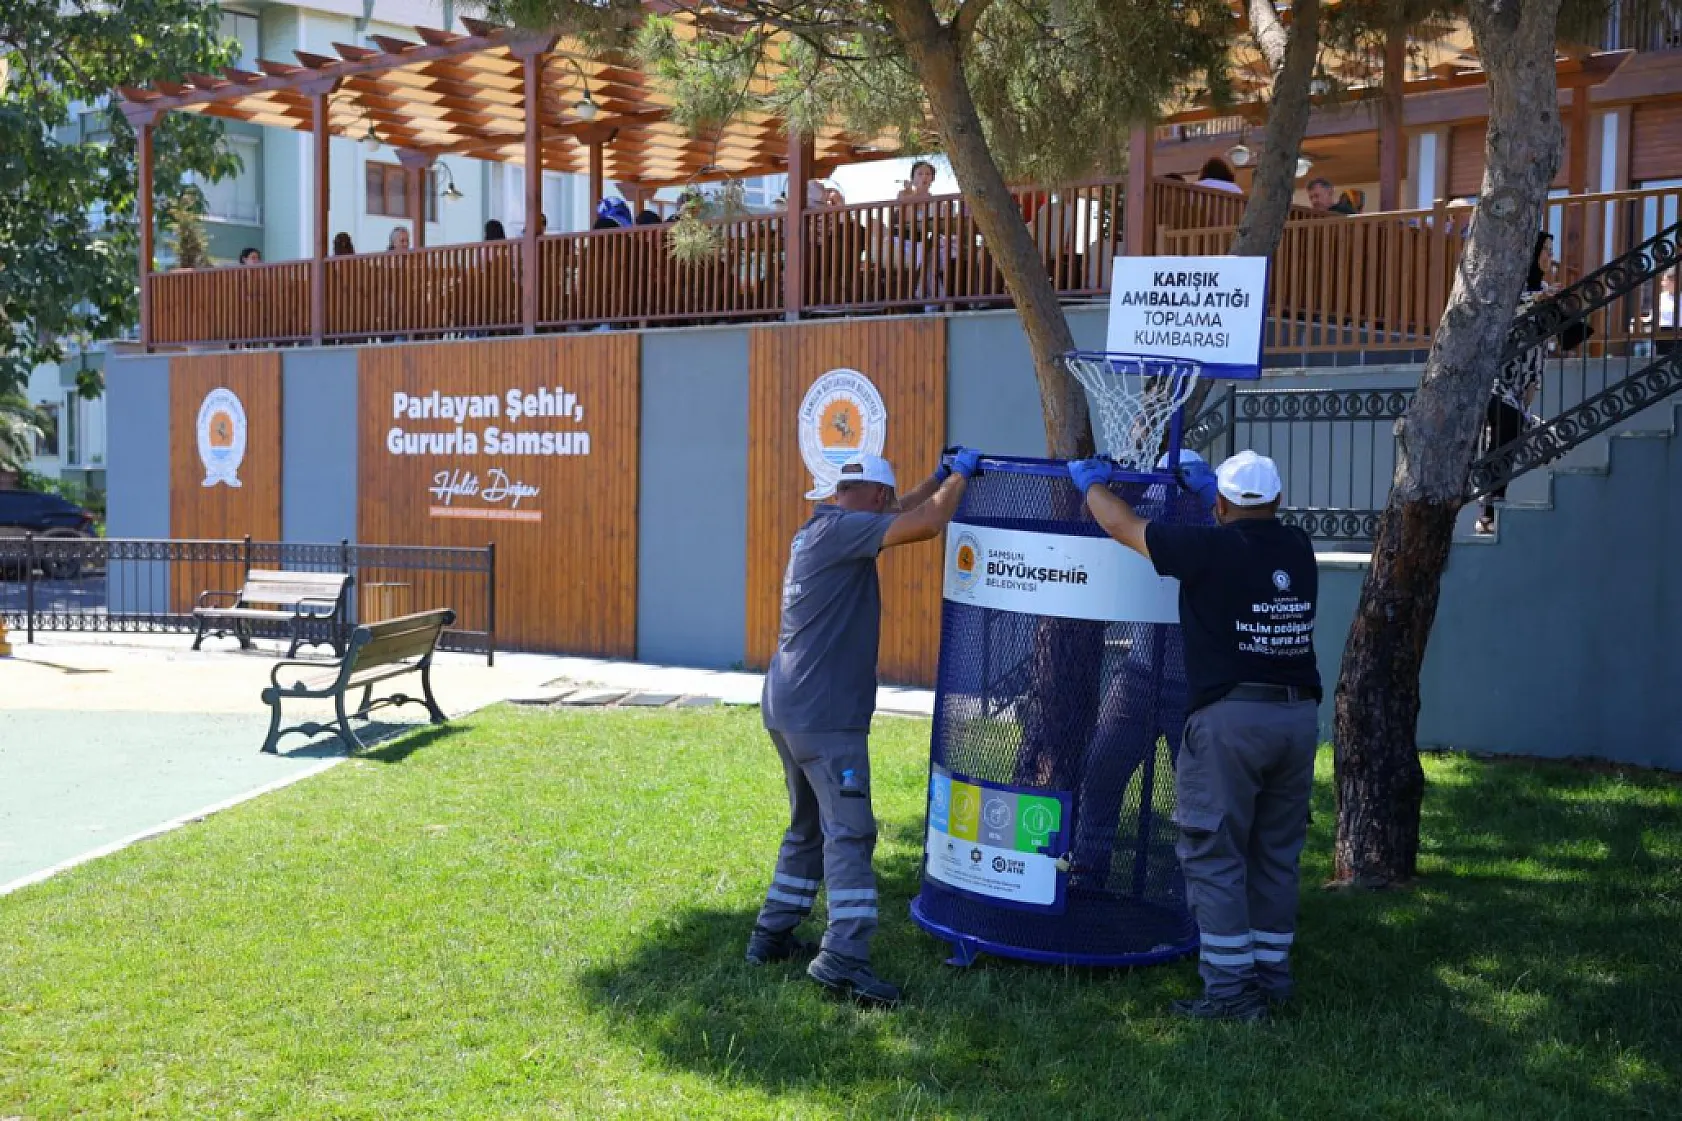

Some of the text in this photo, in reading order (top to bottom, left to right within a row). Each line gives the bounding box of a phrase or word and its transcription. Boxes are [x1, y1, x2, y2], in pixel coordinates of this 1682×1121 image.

[1153, 272, 1220, 291] KARIŞIK
[1121, 288, 1250, 308] AMBALAJ ATIĞI
[1144, 311, 1222, 327] TOPLAMA
[1134, 330, 1230, 348] KUMBARASI
[393, 386, 584, 424] Parlayan Şehir,
[387, 426, 591, 455] Gururla Samsun
[428, 468, 480, 506] Halit
[988, 549, 1025, 562] SAMSUN
[986, 561, 1088, 585] BÜYÜKŞEHİR
[1235, 619, 1271, 634] İKLİM
